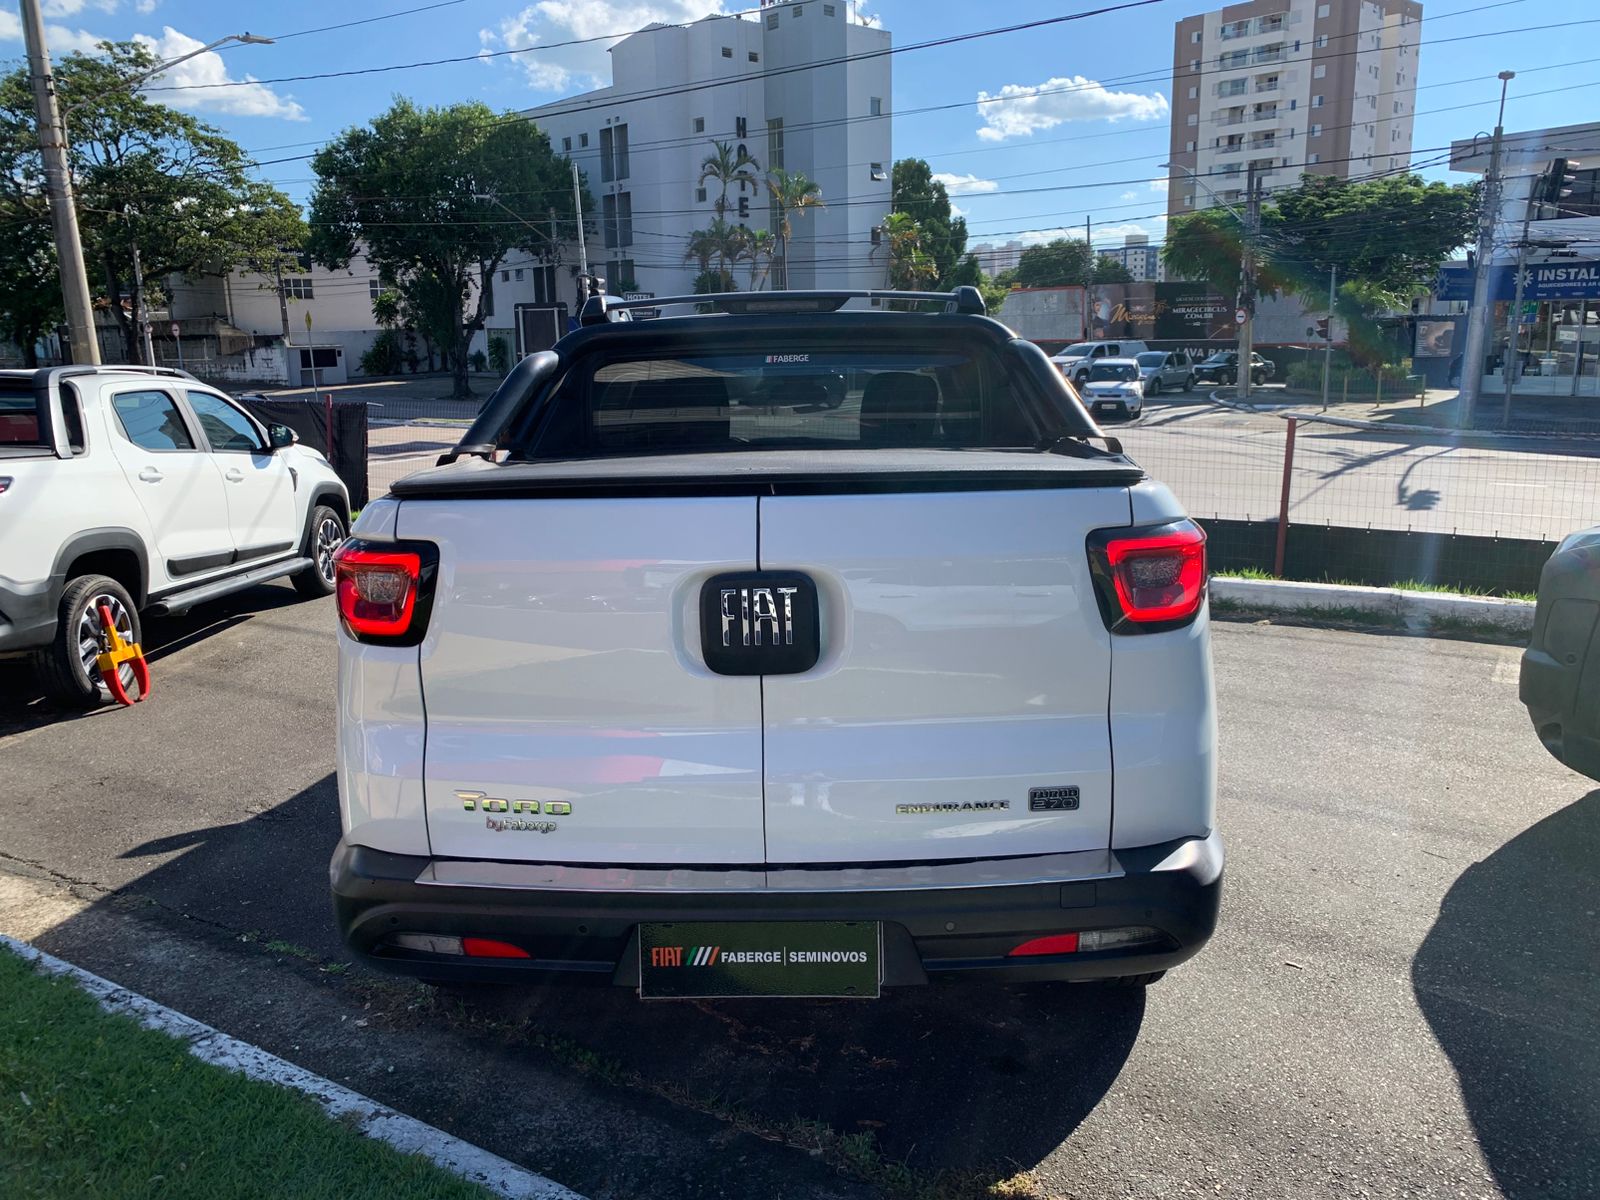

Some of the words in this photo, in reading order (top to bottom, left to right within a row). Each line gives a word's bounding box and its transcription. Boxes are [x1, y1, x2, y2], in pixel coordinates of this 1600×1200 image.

[736, 116, 749, 230] HOTE
[1537, 267, 1600, 281] INSTAL
[1172, 306, 1228, 314] MIRAGECIRCUS
[773, 354, 810, 363] FABERGE
[720, 587, 798, 647] FIAT
[1029, 788, 1078, 798] TURBO
[453, 790, 572, 815] TORO
[896, 799, 1010, 814] ENDURANCE
[1030, 797, 1078, 809] 270
[651, 946, 684, 967] FIAT
[721, 951, 782, 964] FABERGE
[789, 951, 868, 964] SEMINOVOS
